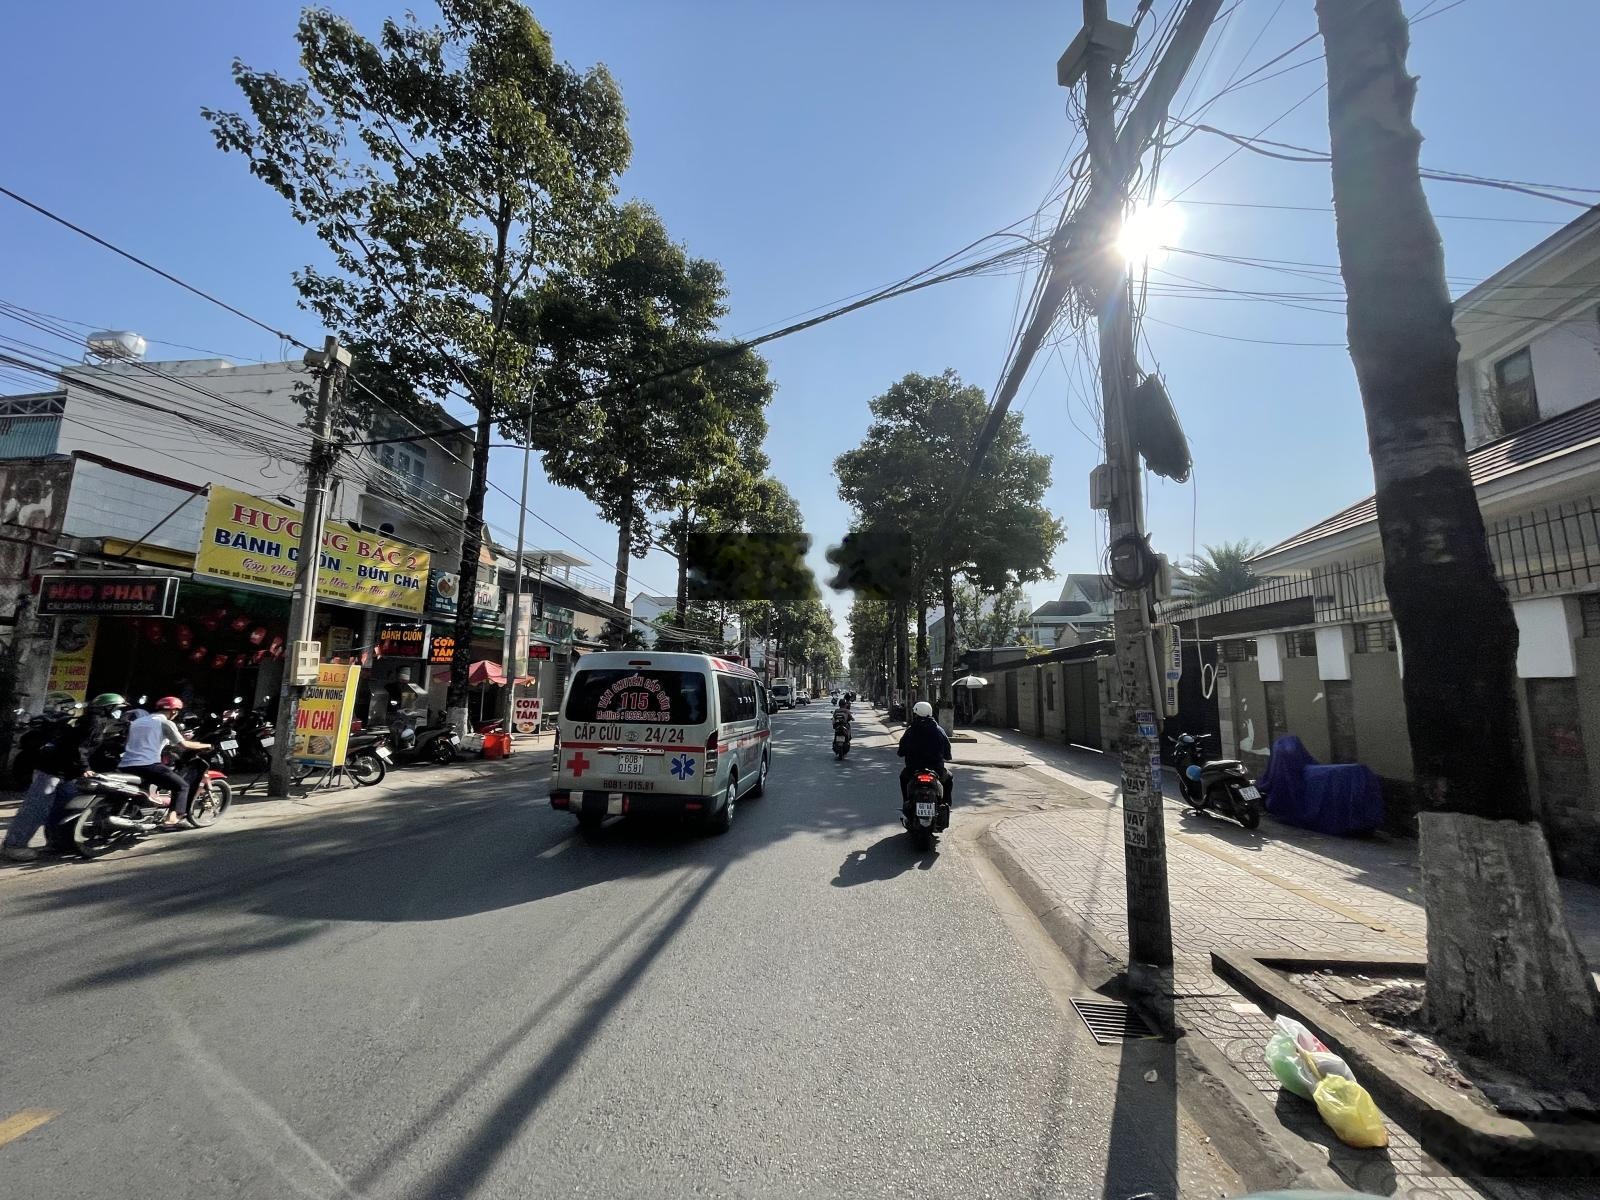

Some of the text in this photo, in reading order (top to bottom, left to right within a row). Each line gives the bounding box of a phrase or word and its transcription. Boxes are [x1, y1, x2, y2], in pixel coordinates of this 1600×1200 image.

[214, 527, 281, 558] BÁNH
[357, 564, 389, 583] BÚN
[393, 574, 420, 590] CHẢ
[356, 540, 401, 566] BẮC
[406, 556, 418, 570] 2
[381, 627, 423, 641] BÁNH CUỐN
[620, 692, 649, 710] 115
[574, 721, 685, 744] CẤP CỨU 24/24
[624, 754, 639, 764] 60B
[1126, 812, 1146, 828] VAY
